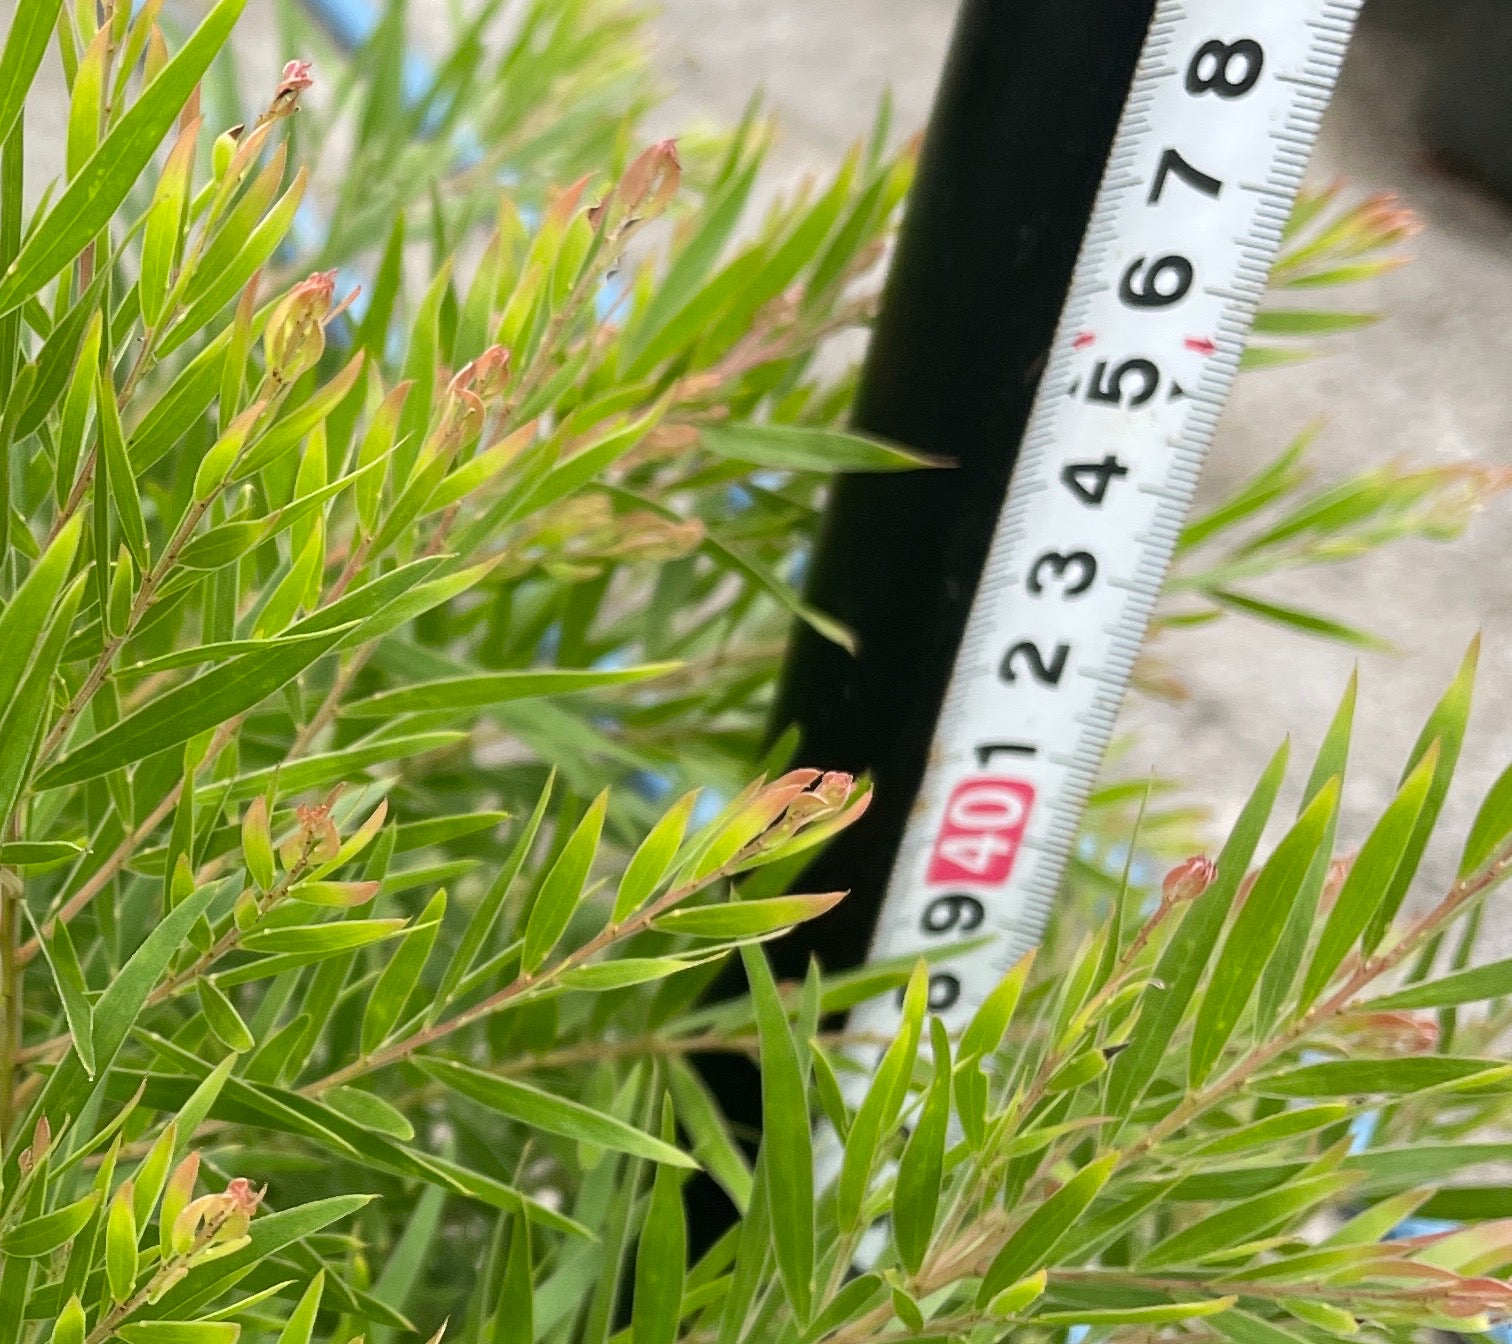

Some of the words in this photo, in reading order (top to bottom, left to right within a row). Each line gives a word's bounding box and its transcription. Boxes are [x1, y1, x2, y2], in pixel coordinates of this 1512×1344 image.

[1185, 38, 1265, 99] 8
[1148, 148, 1223, 205] 7
[1119, 255, 1194, 309] 6
[1087, 358, 1161, 407] 5
[1061, 455, 1129, 506] 4
[1028, 550, 1098, 597] 3
[1000, 640, 1071, 686] 2
[976, 744, 1038, 766] 1
[940, 786, 1024, 875] 40
[920, 894, 986, 936] 9
